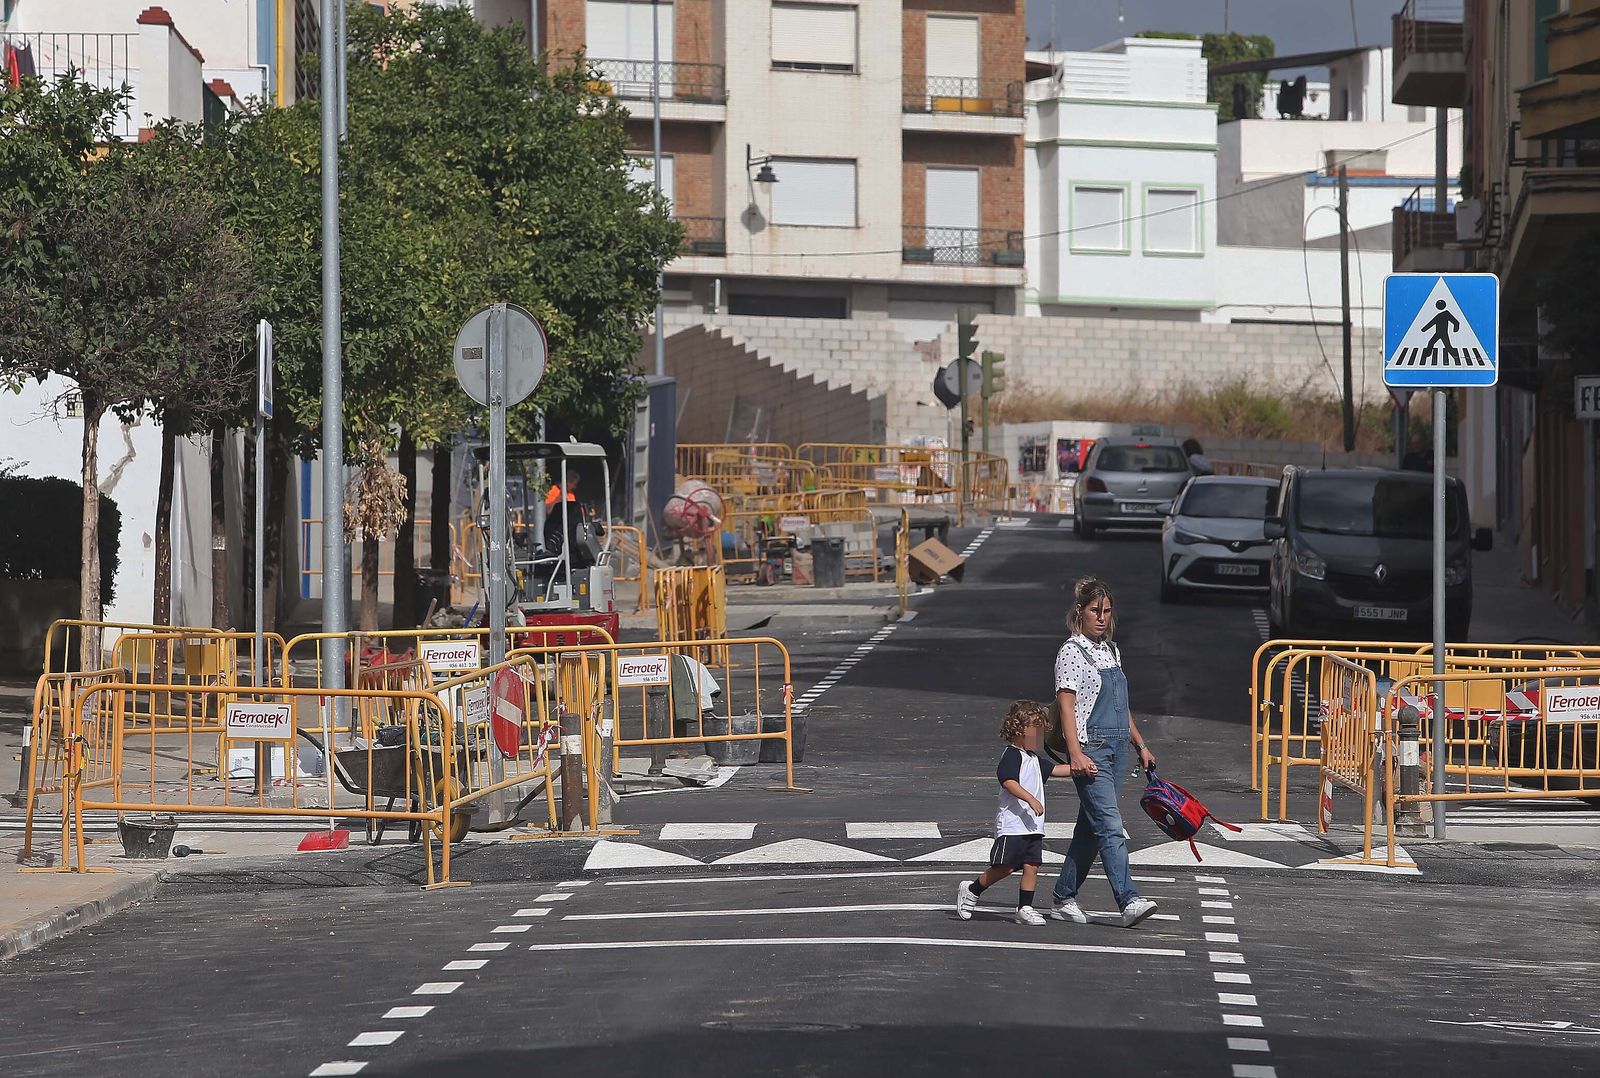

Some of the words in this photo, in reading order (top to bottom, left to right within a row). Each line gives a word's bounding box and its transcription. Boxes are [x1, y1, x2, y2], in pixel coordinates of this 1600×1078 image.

[1360, 607, 1384, 618] 5551
[1388, 609, 1406, 619] JNP
[426, 649, 472, 662] Ferrotek
[622, 663, 663, 676] Ferrotek
[232, 709, 284, 729] Ferrotek
